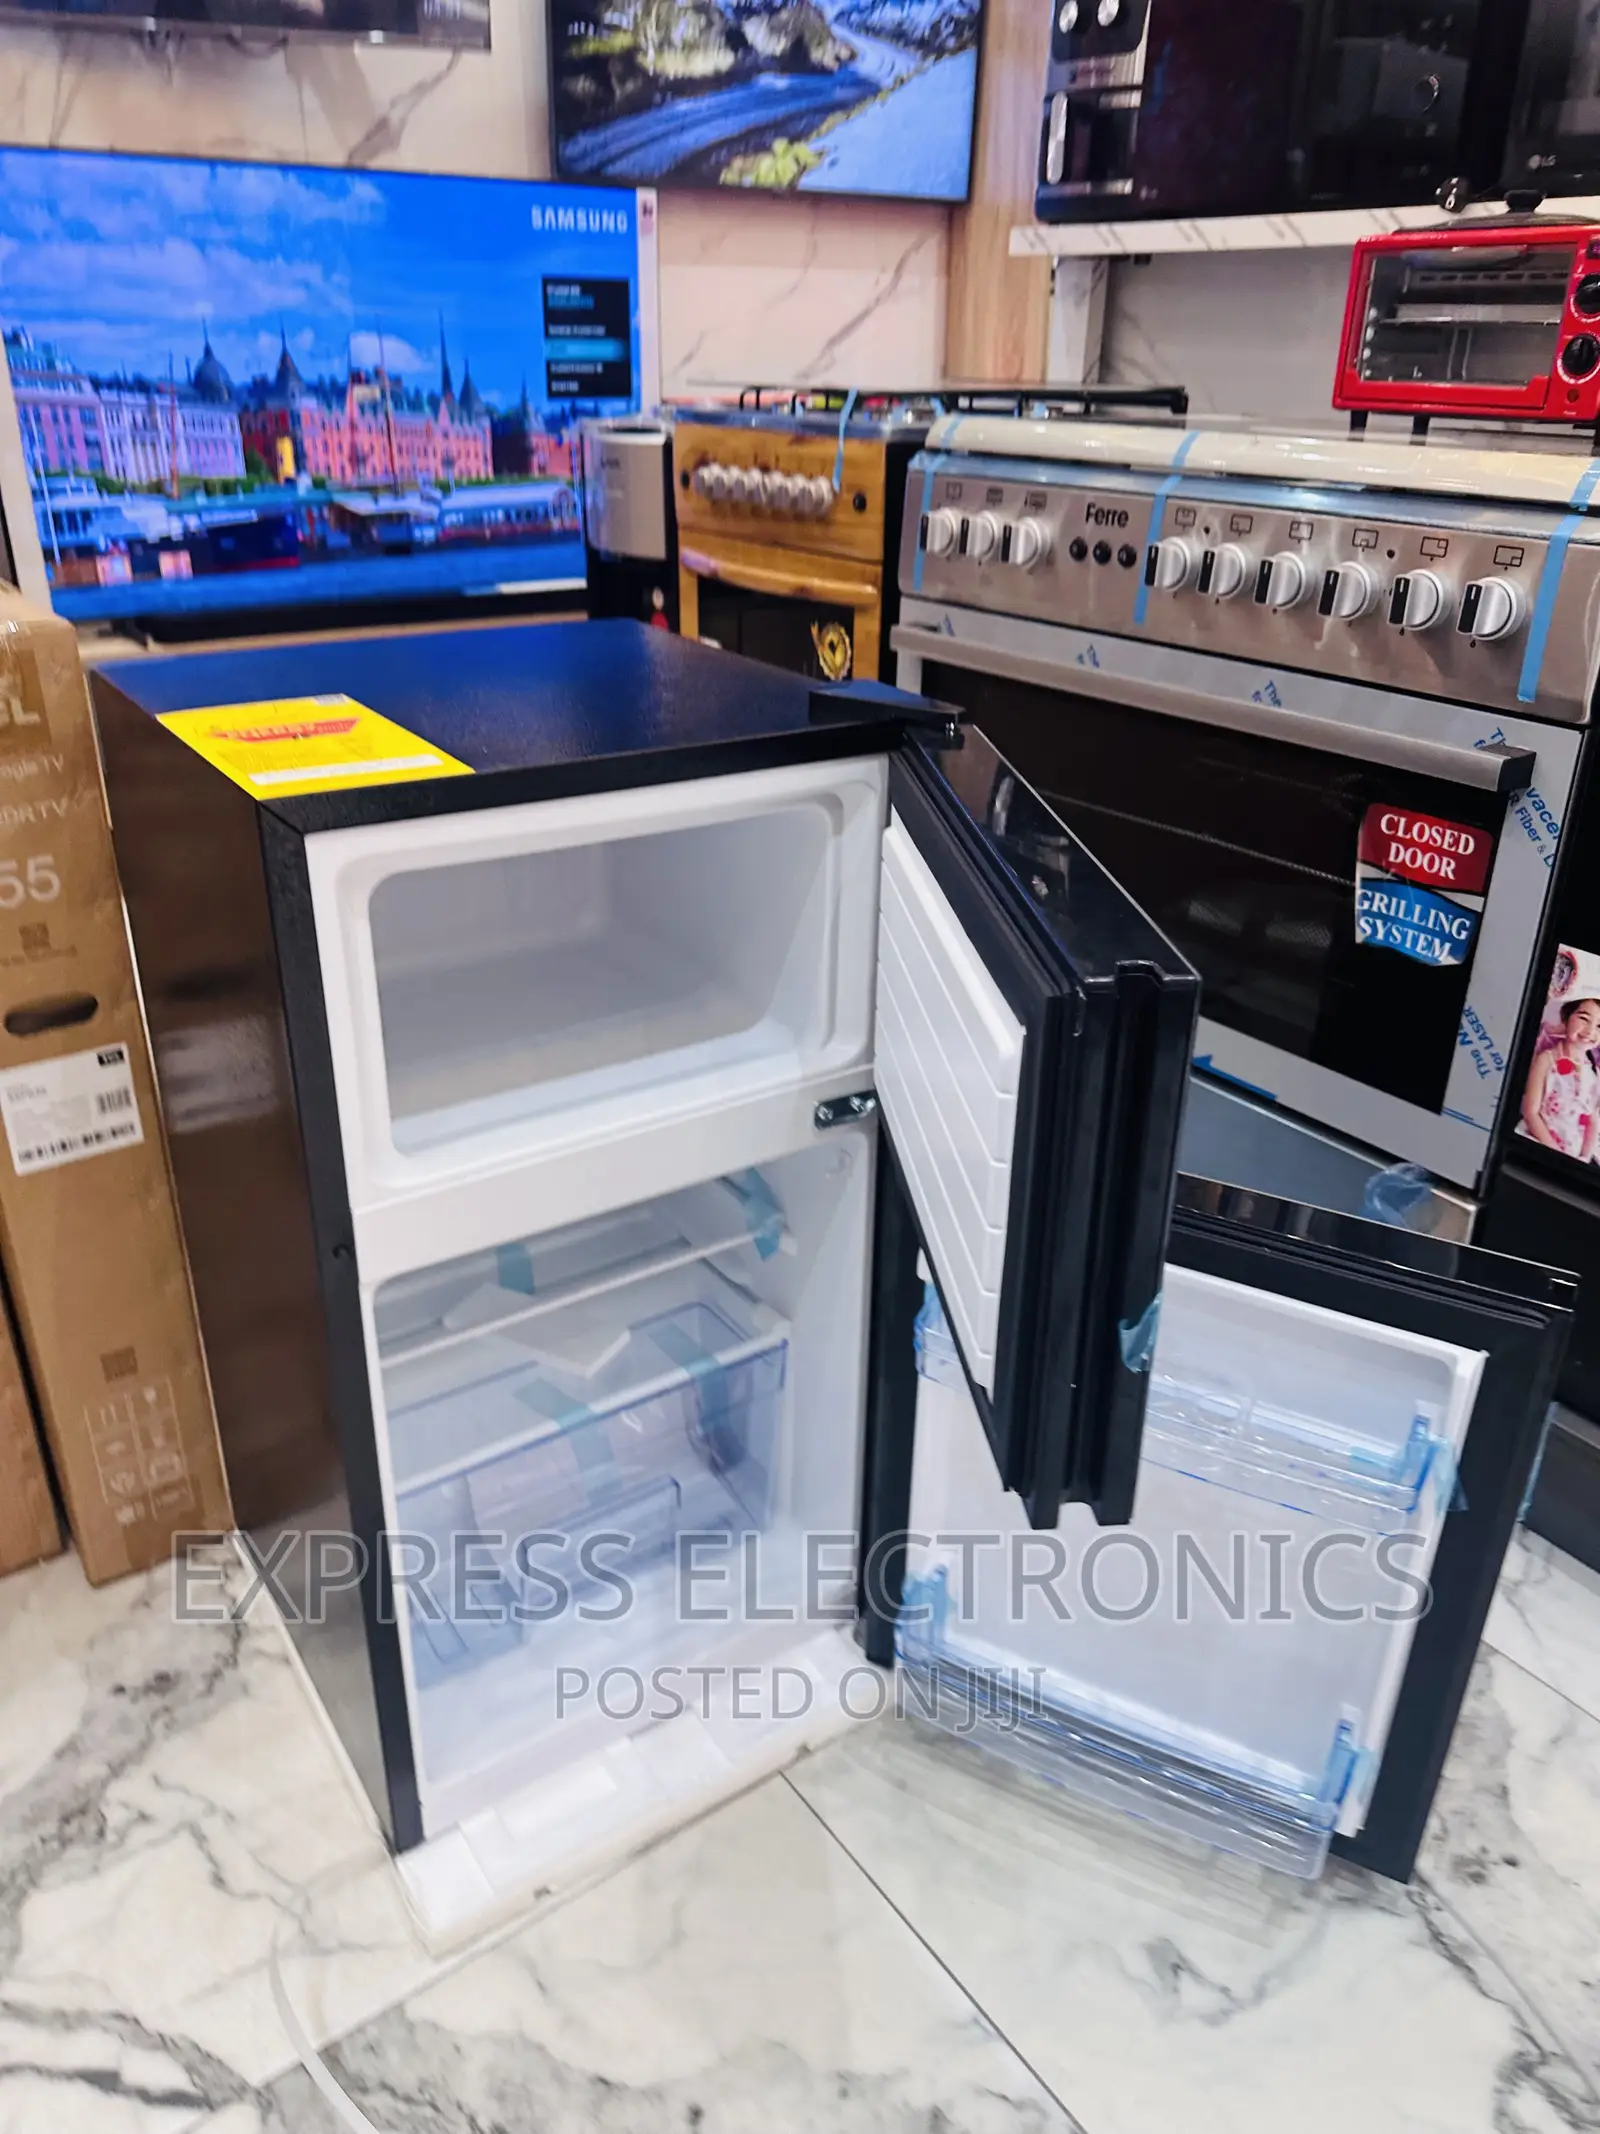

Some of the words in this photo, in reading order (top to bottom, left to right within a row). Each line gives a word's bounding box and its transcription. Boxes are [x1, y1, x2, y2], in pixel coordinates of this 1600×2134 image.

[531, 204, 628, 234] SAMSUNG
[1085, 502, 1129, 528] Ferre
[1380, 813, 1475, 855] CLOSED
[1515, 806, 1542, 843] Fiber
[0, 853, 61, 909] 55
[1388, 841, 1456, 880] DOOR
[1356, 889, 1471, 940] GRILLING
[1358, 915, 1453, 961] SYSTEM
[1463, 1005, 1494, 1050] LASER
